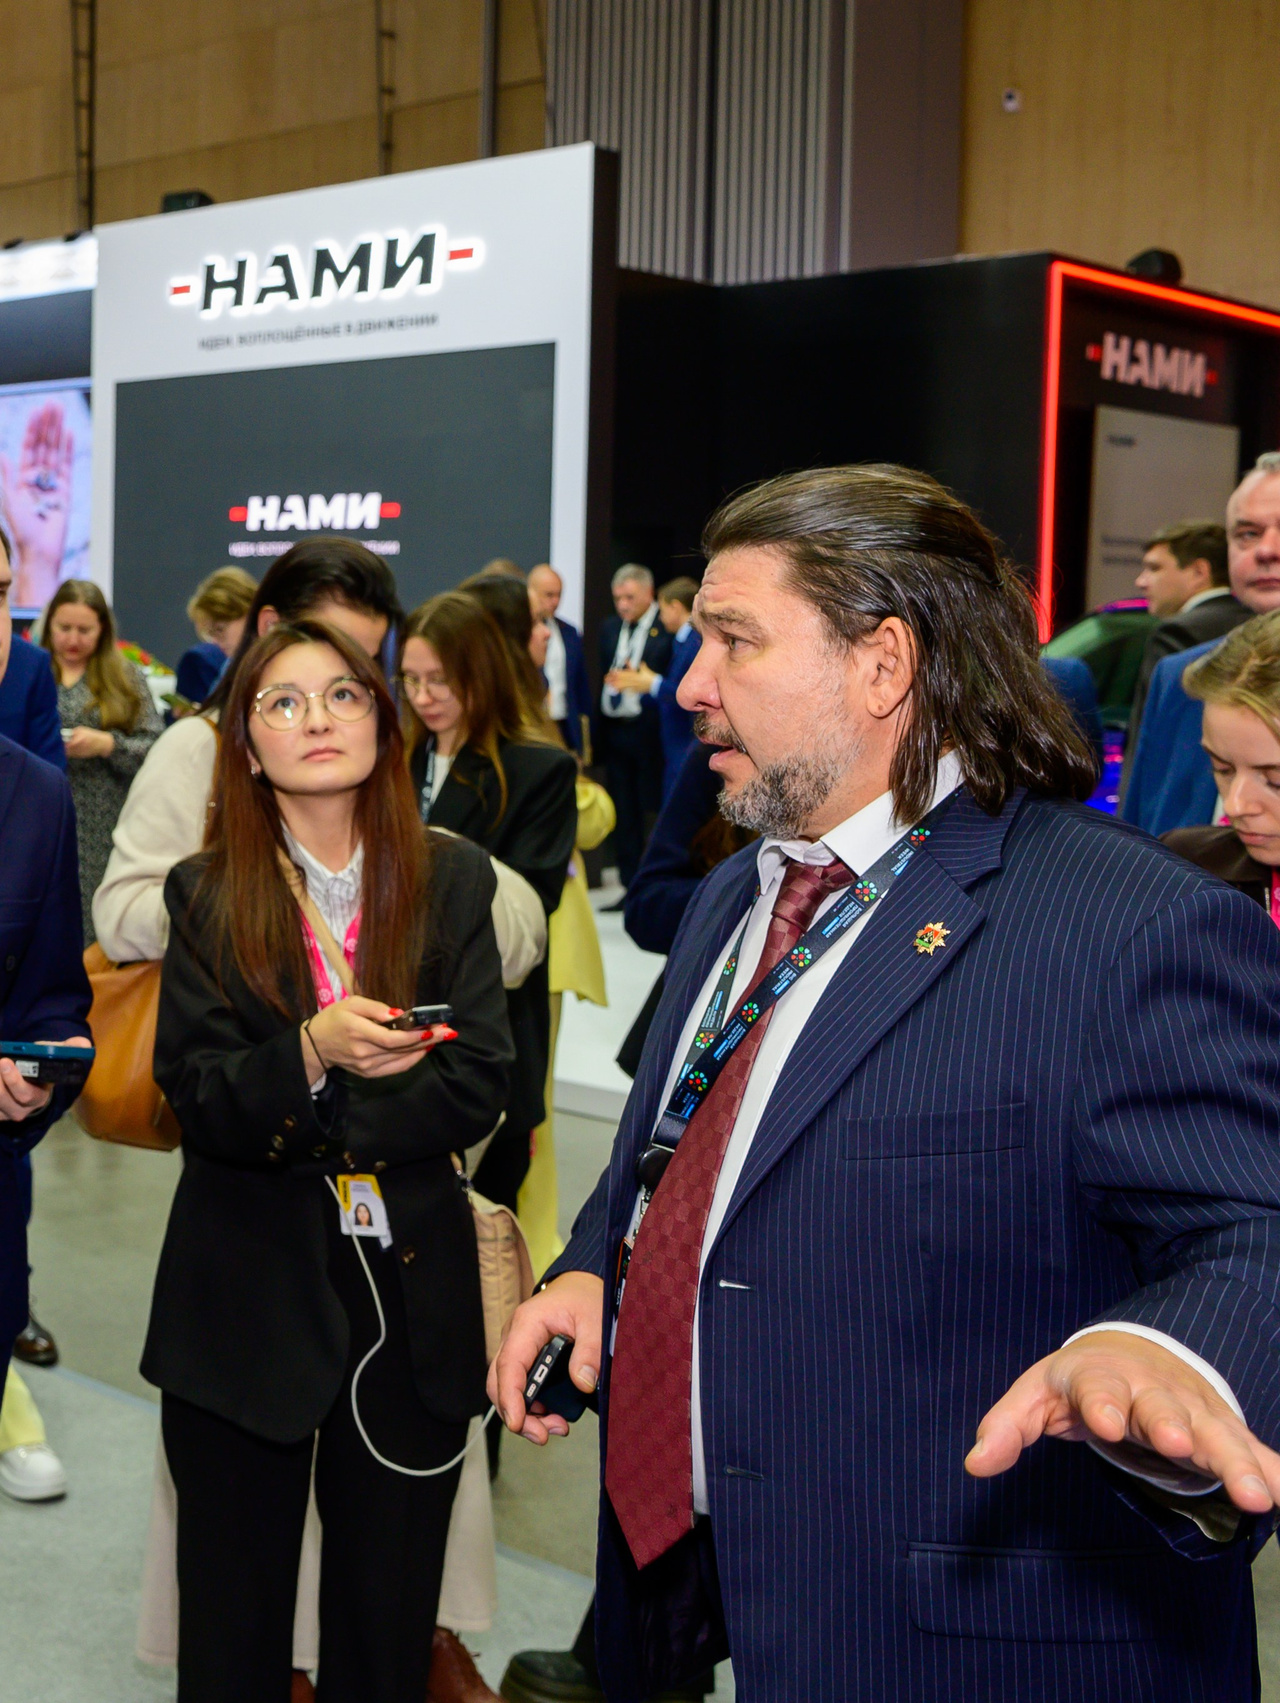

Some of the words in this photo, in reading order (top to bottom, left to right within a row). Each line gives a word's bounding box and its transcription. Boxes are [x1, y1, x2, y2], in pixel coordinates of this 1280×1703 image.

[202, 232, 437, 311] НАМИ
[1101, 331, 1206, 398] НАМИ
[246, 491, 382, 531] НАМИ
